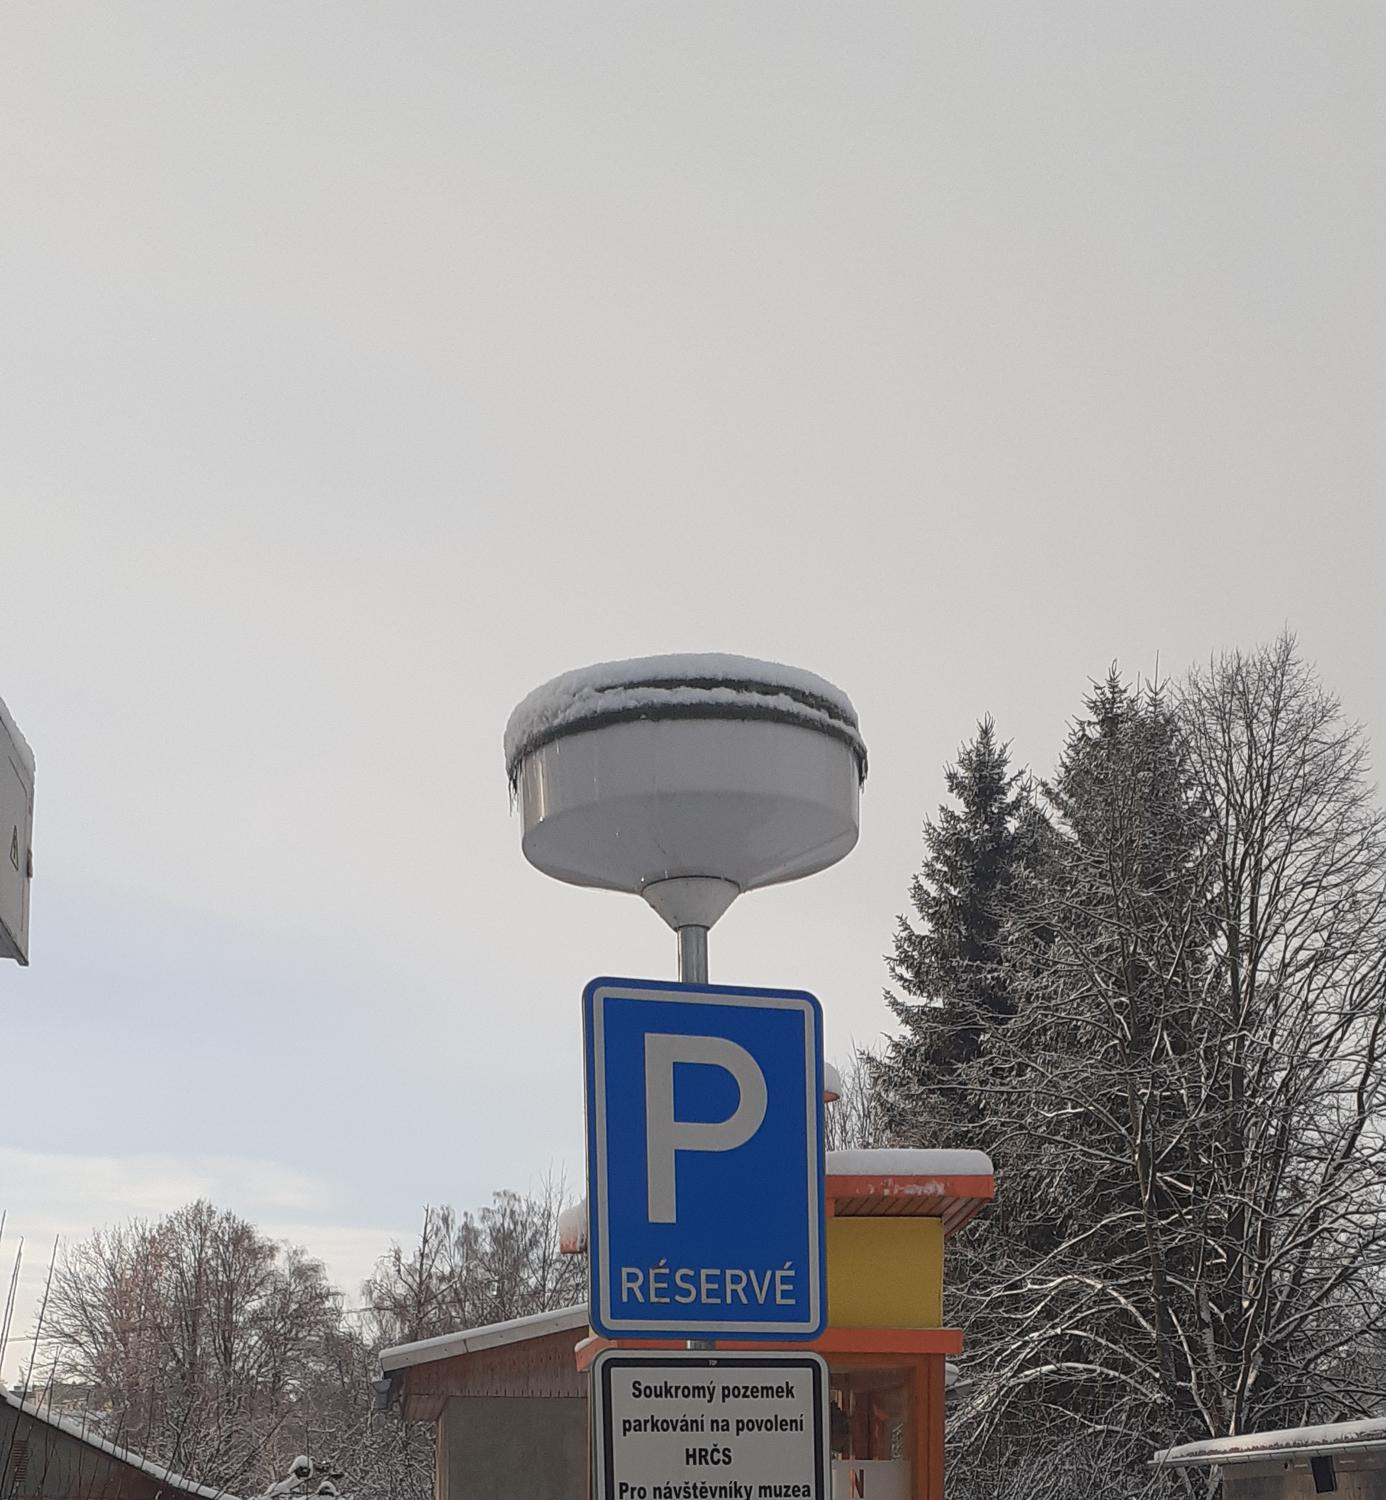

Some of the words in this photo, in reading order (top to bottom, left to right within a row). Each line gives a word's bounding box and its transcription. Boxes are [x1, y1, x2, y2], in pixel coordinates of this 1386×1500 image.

[644, 1033, 768, 1223] P
[621, 1259, 796, 1305] RÉSERVÉ
[632, 1381, 715, 1403] Soukromý
[722, 1381, 794, 1403] pozemek
[623, 1414, 704, 1436] parkování
[711, 1419, 729, 1432] na
[736, 1414, 803, 1436] povolení
[686, 1444, 731, 1465] HRČS
[619, 1482, 646, 1499] Pro
[759, 1485, 810, 1498] muzea
